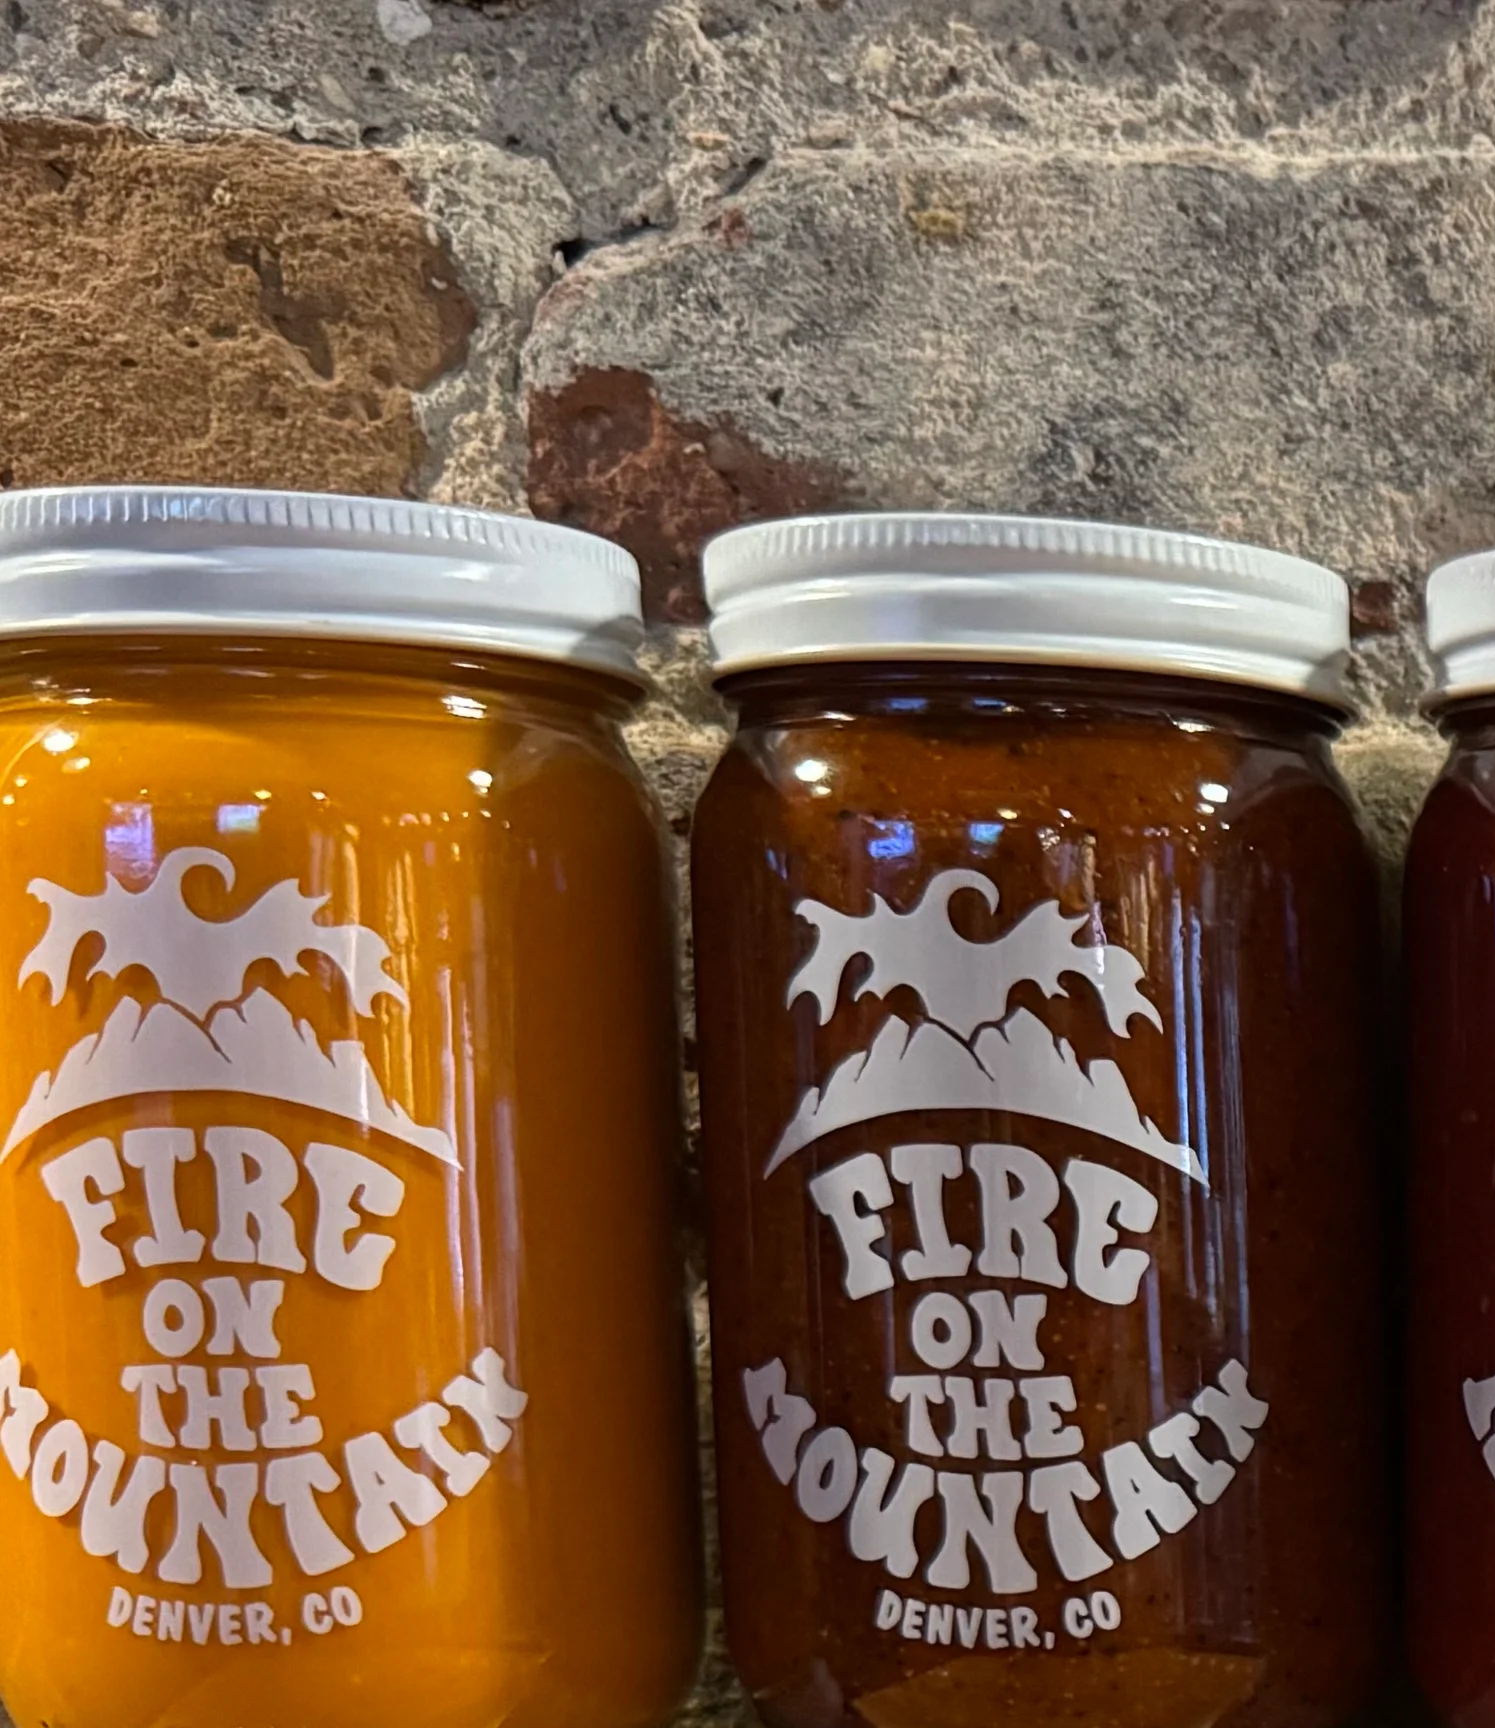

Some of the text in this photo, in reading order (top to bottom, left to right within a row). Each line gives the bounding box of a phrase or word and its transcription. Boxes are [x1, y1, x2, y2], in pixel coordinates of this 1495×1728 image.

[42, 1126, 405, 1290] FIRE
[809, 1143, 1158, 1305] FIRE
[142, 1278, 282, 1359] ON
[912, 1291, 1047, 1371] ON
[119, 1363, 324, 1451] THE
[890, 1375, 1083, 1462] THE
[0, 1349, 529, 1589] MOUNTAIN
[744, 1358, 1269, 1594] MOUNTAIN
[107, 1585, 362, 1648] DENVER, CO
[877, 1589, 1122, 1651] DENVER, CO
